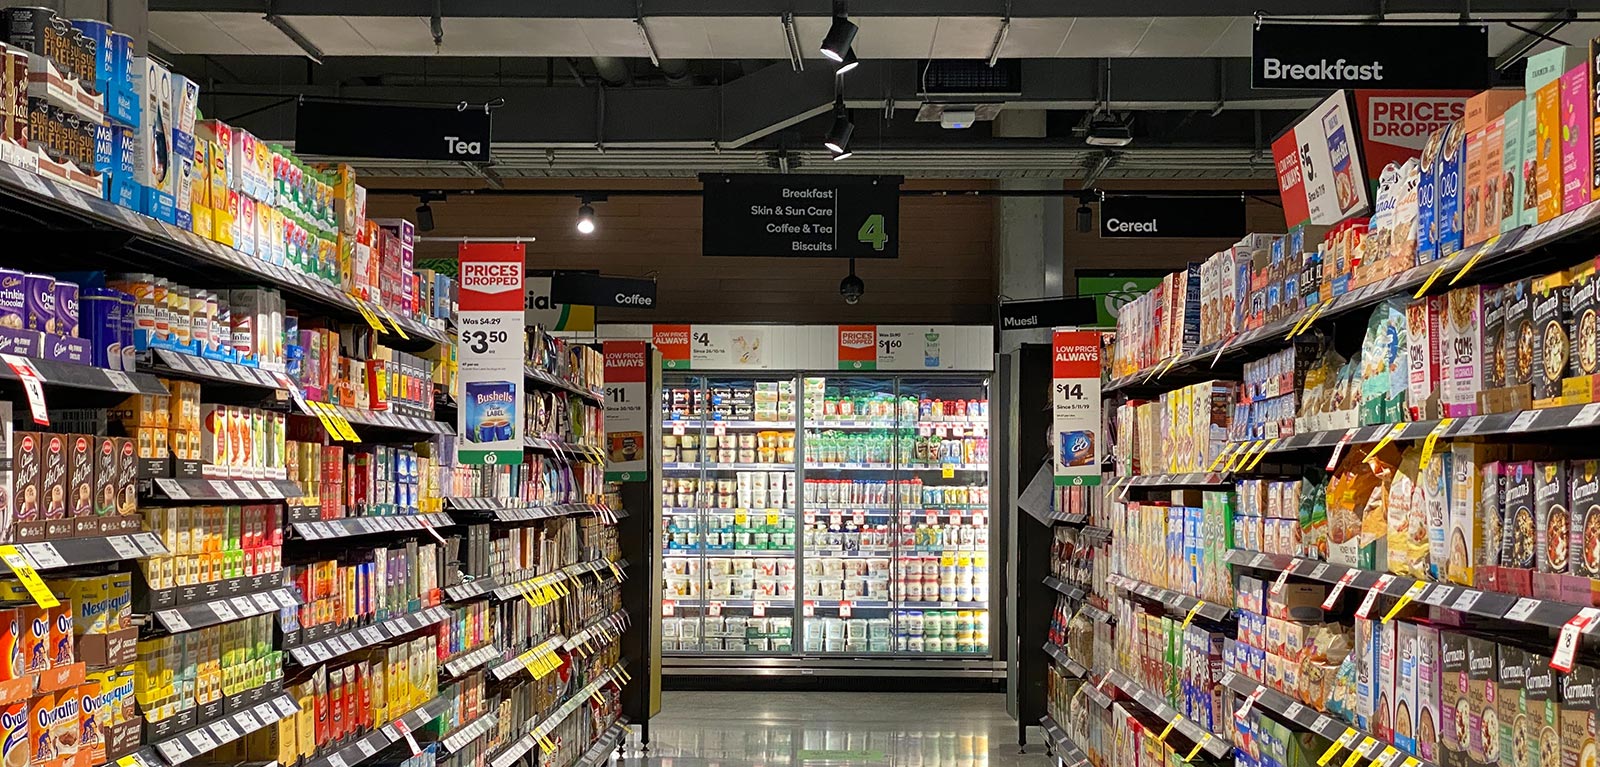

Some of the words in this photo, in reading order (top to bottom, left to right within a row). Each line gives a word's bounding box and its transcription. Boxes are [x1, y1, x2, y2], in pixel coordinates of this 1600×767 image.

[1263, 58, 1383, 80] Breakfast
[1373, 102, 1464, 120] PRICES
[1373, 122, 1449, 136] DROPP
[96, 141, 112, 156] Mil
[444, 136, 481, 155] Tea
[96, 154, 110, 164] Drin
[1300, 142, 1314, 182] $5
[1281, 166, 1300, 192] ALWAYS
[782, 188, 833, 198] Breakfast
[751, 206, 773, 216] Skin
[775, 206, 783, 216] &
[785, 206, 805, 216] Sun
[807, 207, 833, 216] Care
[766, 224, 800, 233] Coffee
[802, 224, 811, 233] &
[814, 224, 833, 234] Tea
[1106, 218, 1158, 232] Cereal
[858, 214, 888, 251] 4
[792, 241, 832, 251] Biscuits
[465, 265, 518, 276] PRICES
[464, 277, 518, 286] DROPPED
[615, 294, 651, 306] Coffee
[1004, 316, 1038, 326] Muesli
[693, 332, 710, 346] $4
[606, 359, 644, 367] ALWAYS
[1056, 353, 1098, 362] ALWAYS
[477, 390, 513, 404] Bushells
[606, 388, 625, 402] $11
[1056, 384, 1083, 400] $14
